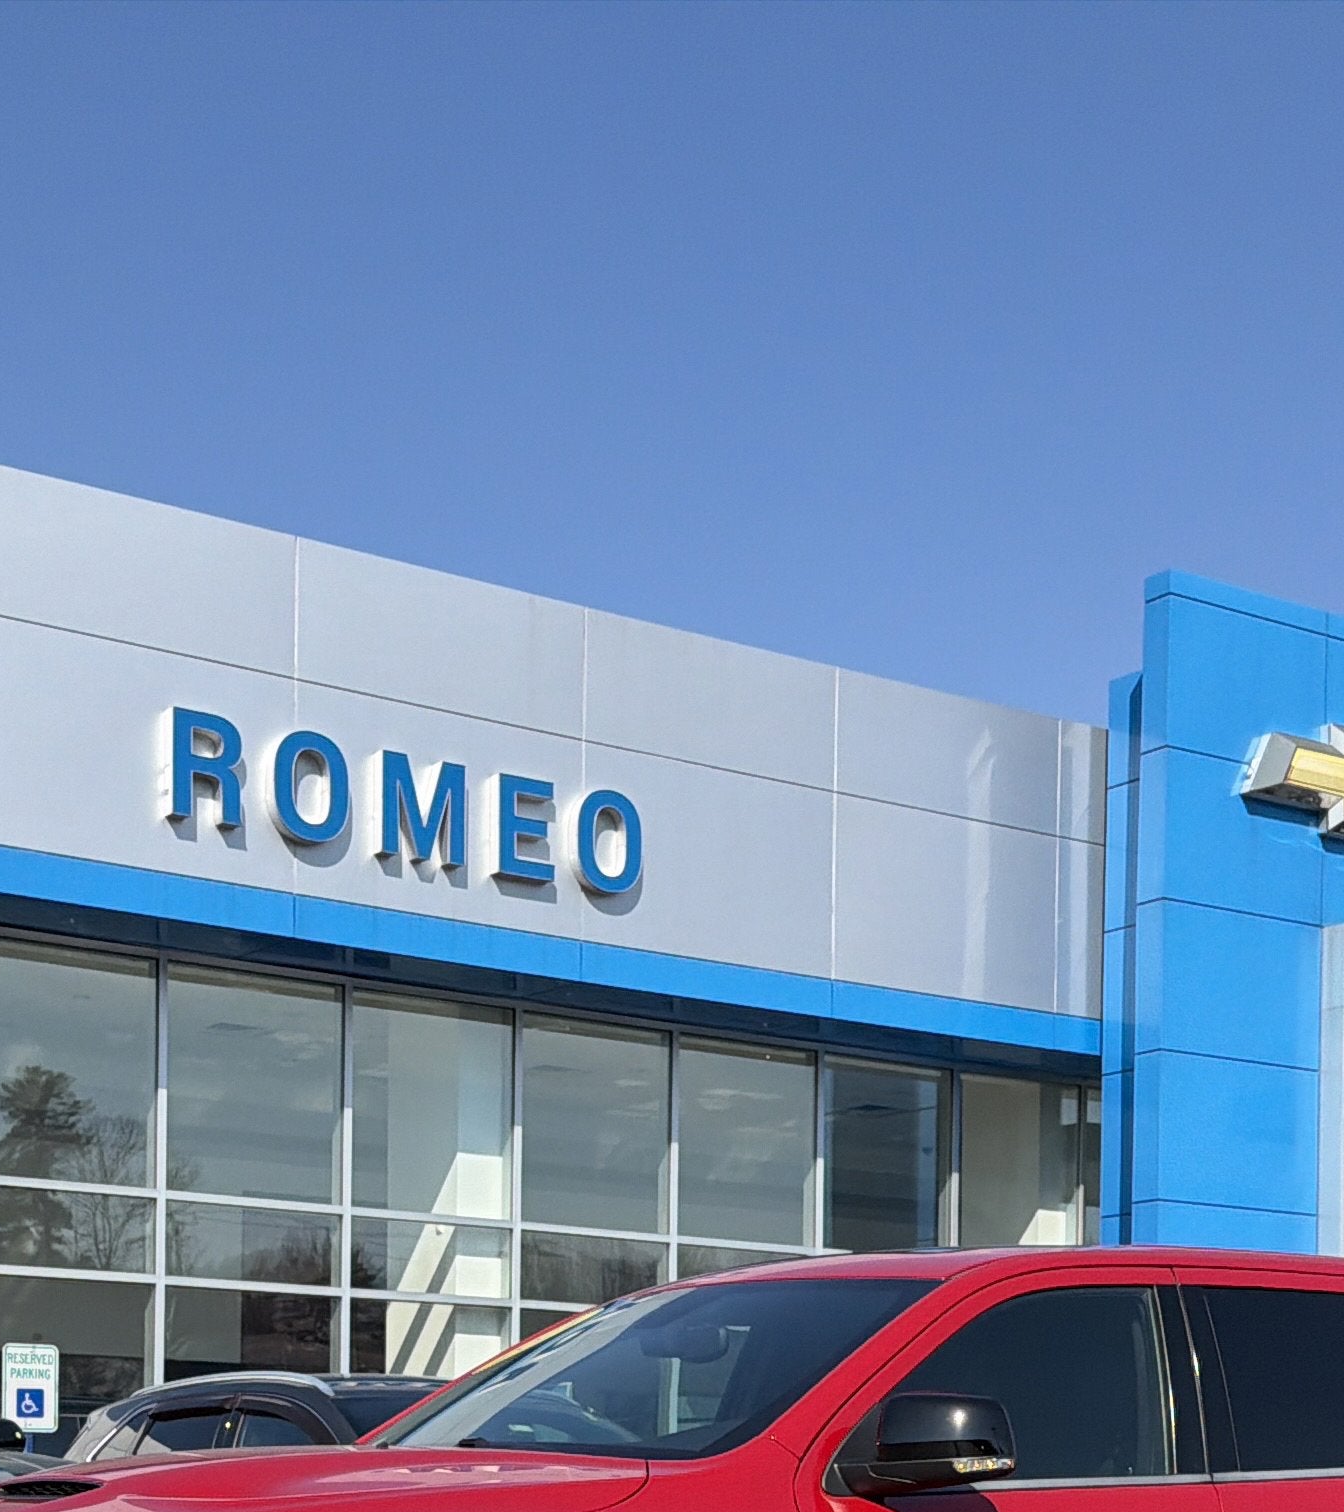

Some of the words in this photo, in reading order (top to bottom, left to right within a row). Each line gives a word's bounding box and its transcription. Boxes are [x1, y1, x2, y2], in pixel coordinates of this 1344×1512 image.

[165, 706, 642, 894] ROMEO
[7, 1352, 54, 1365] RESERVED
[10, 1367, 51, 1380] PARKING
